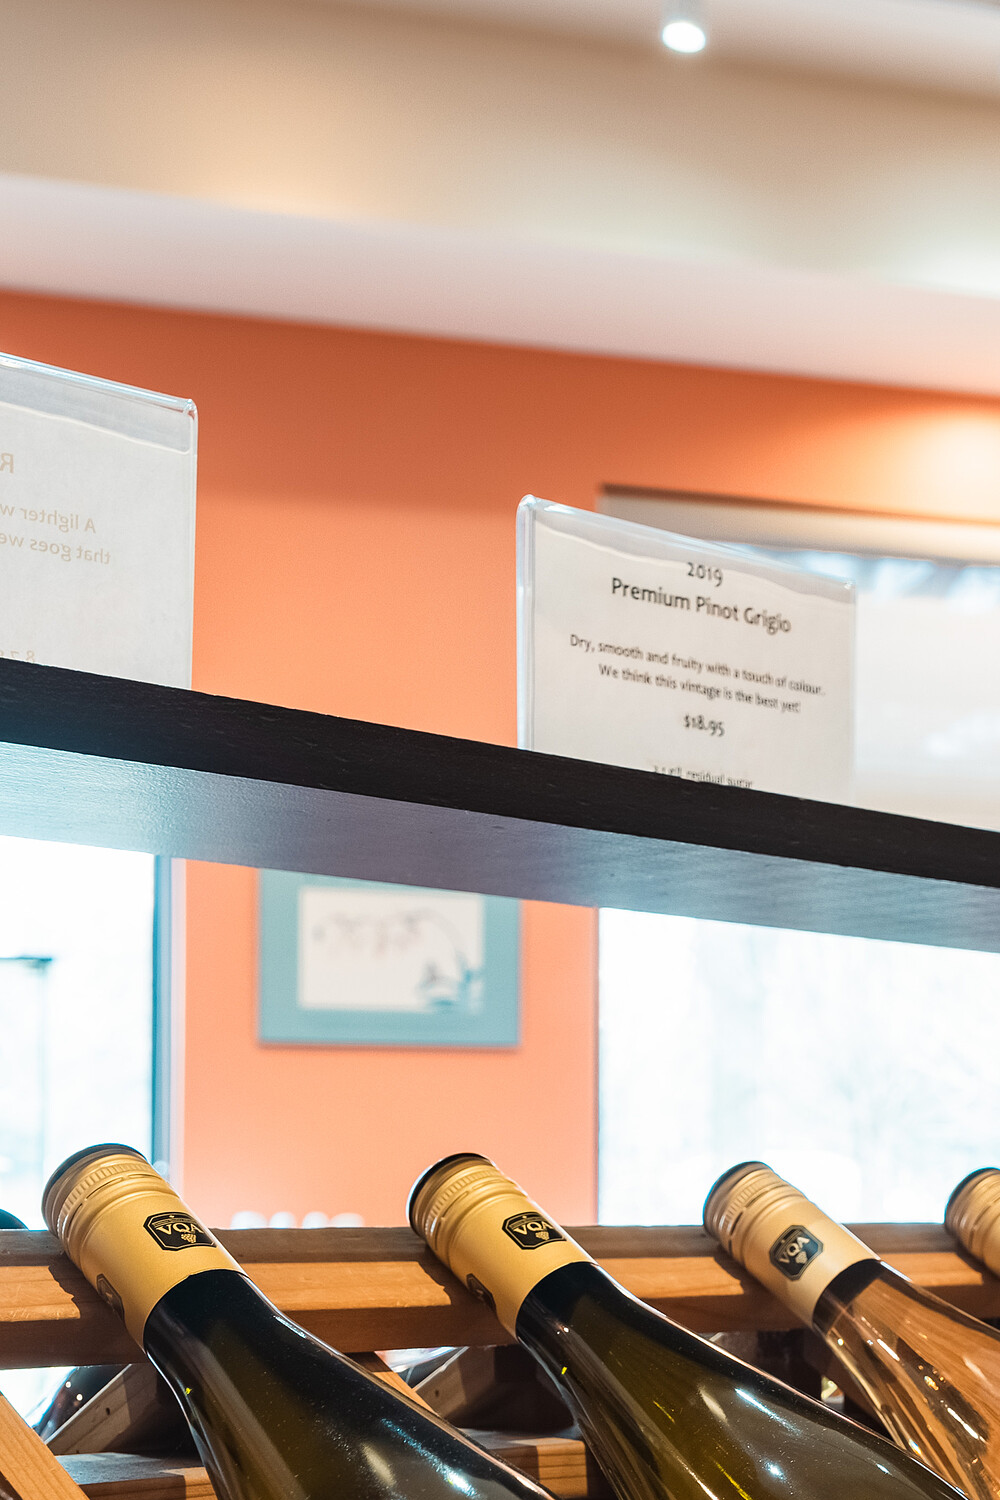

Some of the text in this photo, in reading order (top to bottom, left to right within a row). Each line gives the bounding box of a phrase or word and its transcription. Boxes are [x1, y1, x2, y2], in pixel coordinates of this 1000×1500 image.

[686, 561, 724, 588] 2019
[611, 577, 792, 636] Premium Pinot Grigio
[569, 634, 595, 652] Dry,
[598, 641, 644, 660] smooth
[646, 651, 669, 665] and
[671, 654, 703, 674] fruity
[705, 662, 731, 677] with
[741, 668, 774, 688] touch
[775, 675, 787, 688] of
[598, 663, 619, 679] We
[621, 667, 651, 685] think
[655, 674, 677, 690] this
[679, 679, 722, 700] vintage
[735, 689, 752, 705] the
[754, 693, 779, 707] best
[683, 713, 726, 738] $18.95
[155, 1222, 204, 1236] VQA
[513, 1220, 555, 1236] VQA
[778, 1236, 810, 1264] VQA
